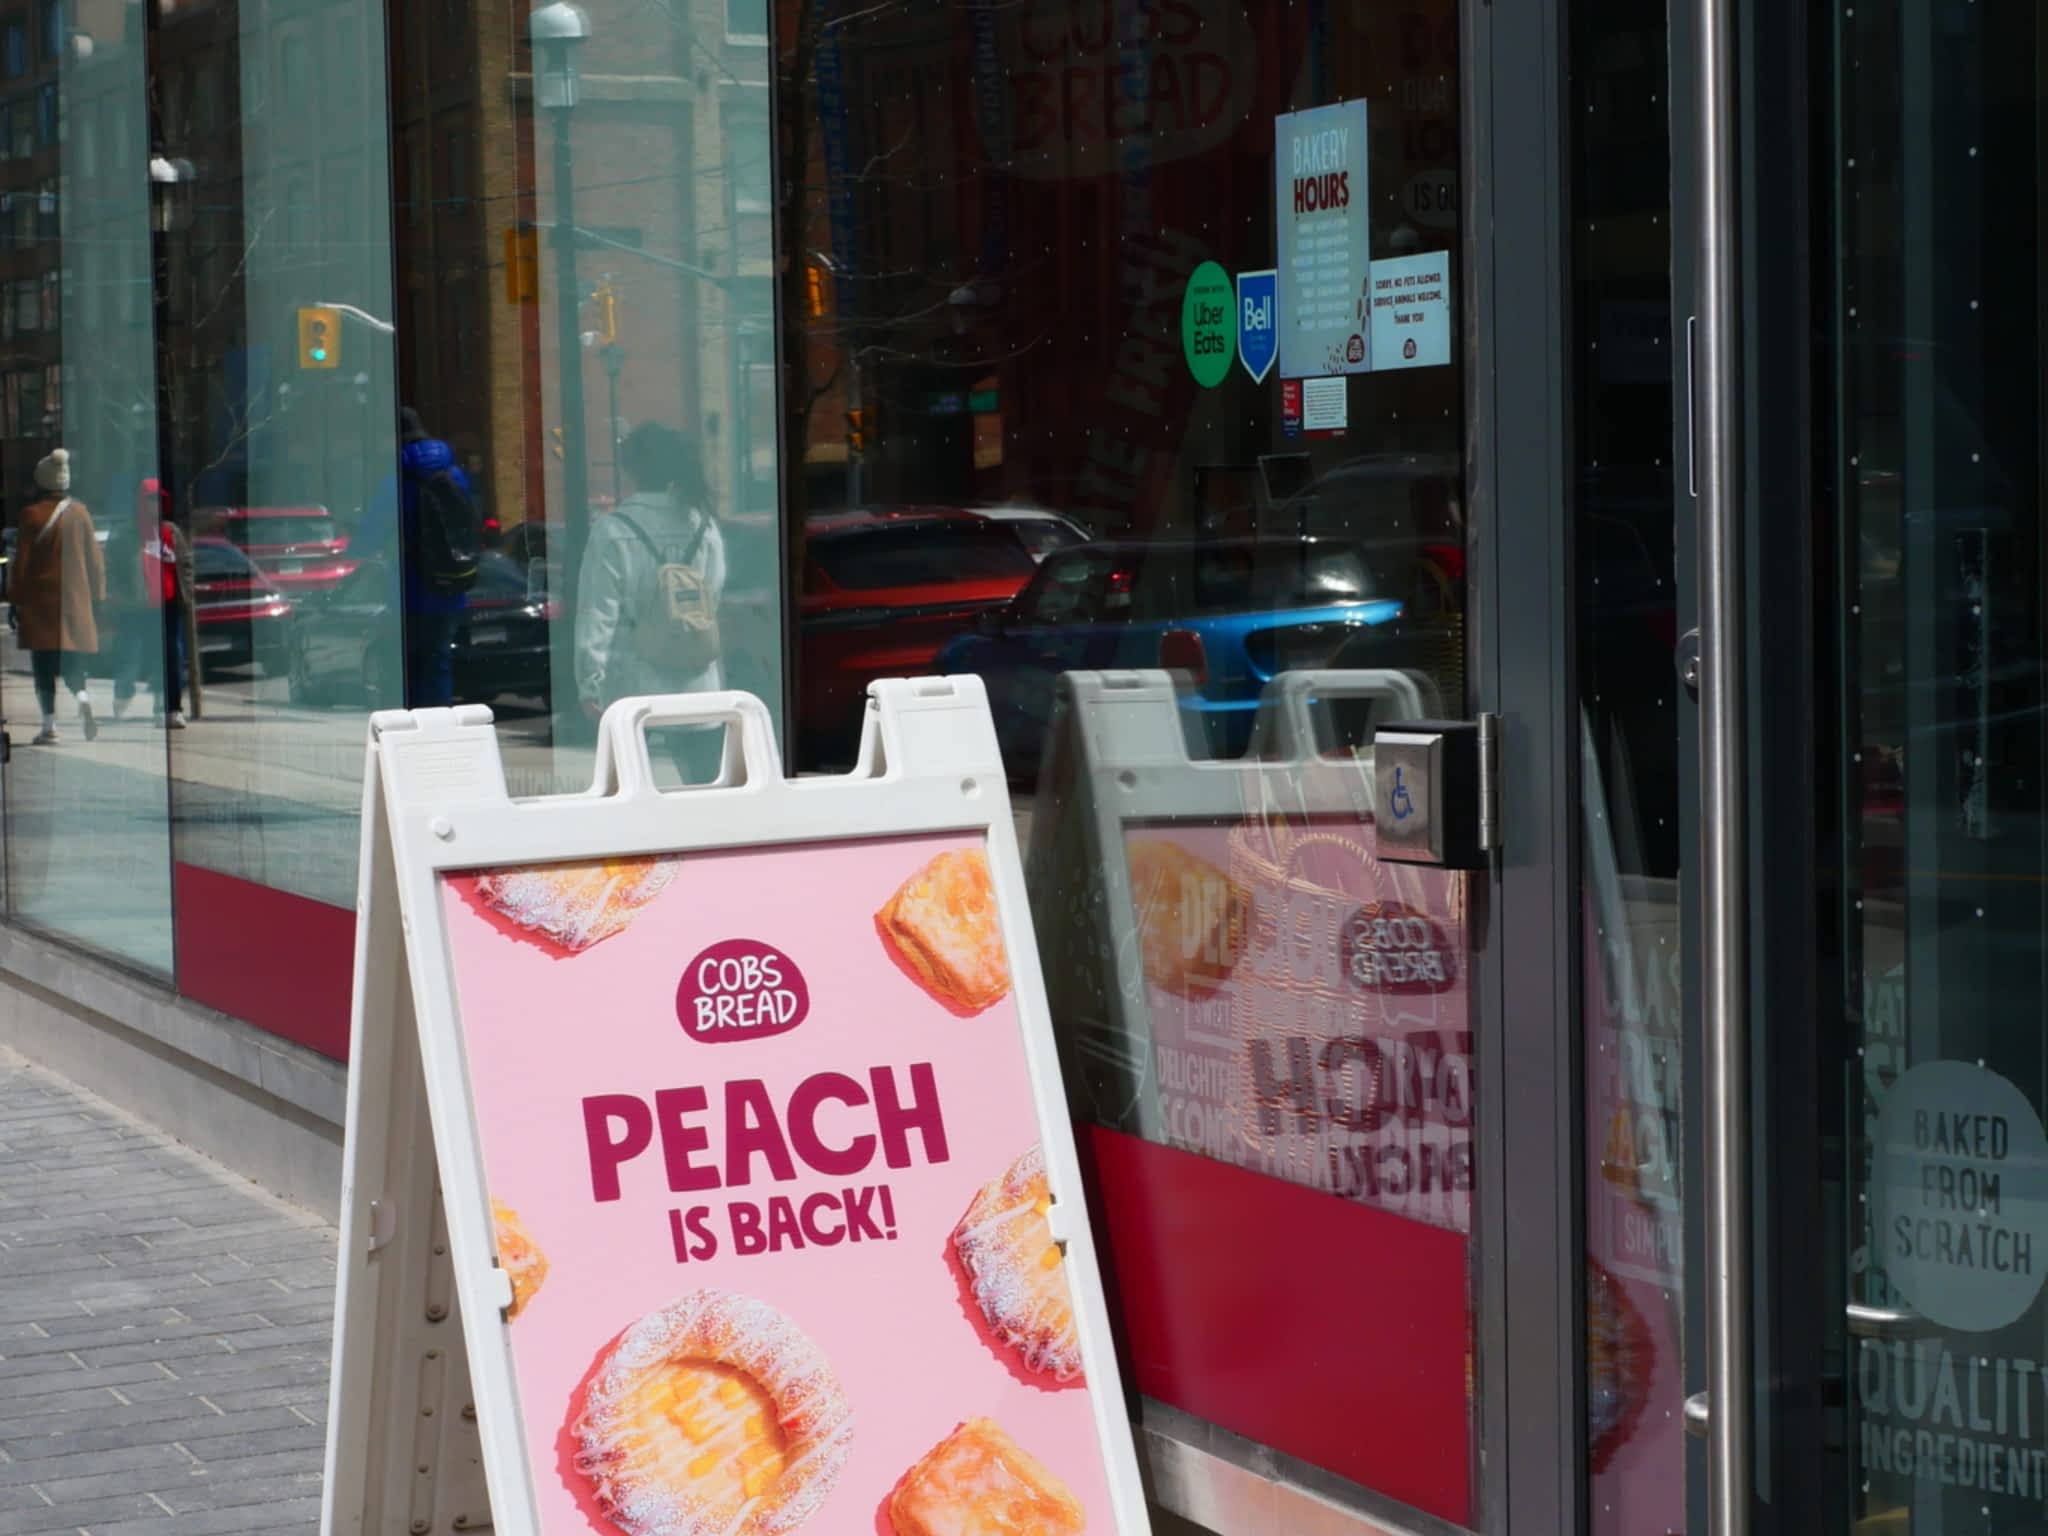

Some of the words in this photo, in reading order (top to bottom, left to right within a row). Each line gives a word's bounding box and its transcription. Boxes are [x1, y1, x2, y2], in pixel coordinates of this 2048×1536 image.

[1293, 127, 1349, 174] BAKERY
[1294, 171, 1349, 214] HOURS
[1192, 301, 1225, 327] Uber
[1244, 295, 1271, 332] Bell
[1193, 331, 1225, 355] Eats
[697, 954, 783, 996] COBS
[693, 989, 799, 1033] BREAD
[580, 1061, 951, 1204] PEACH
[1912, 1109, 2010, 1161] BAKED
[1921, 1164, 2001, 1215] FROM
[667, 1205, 718, 1264] IS
[726, 1184, 899, 1257] BACK!
[1894, 1215, 2032, 1275] SCRATCH
